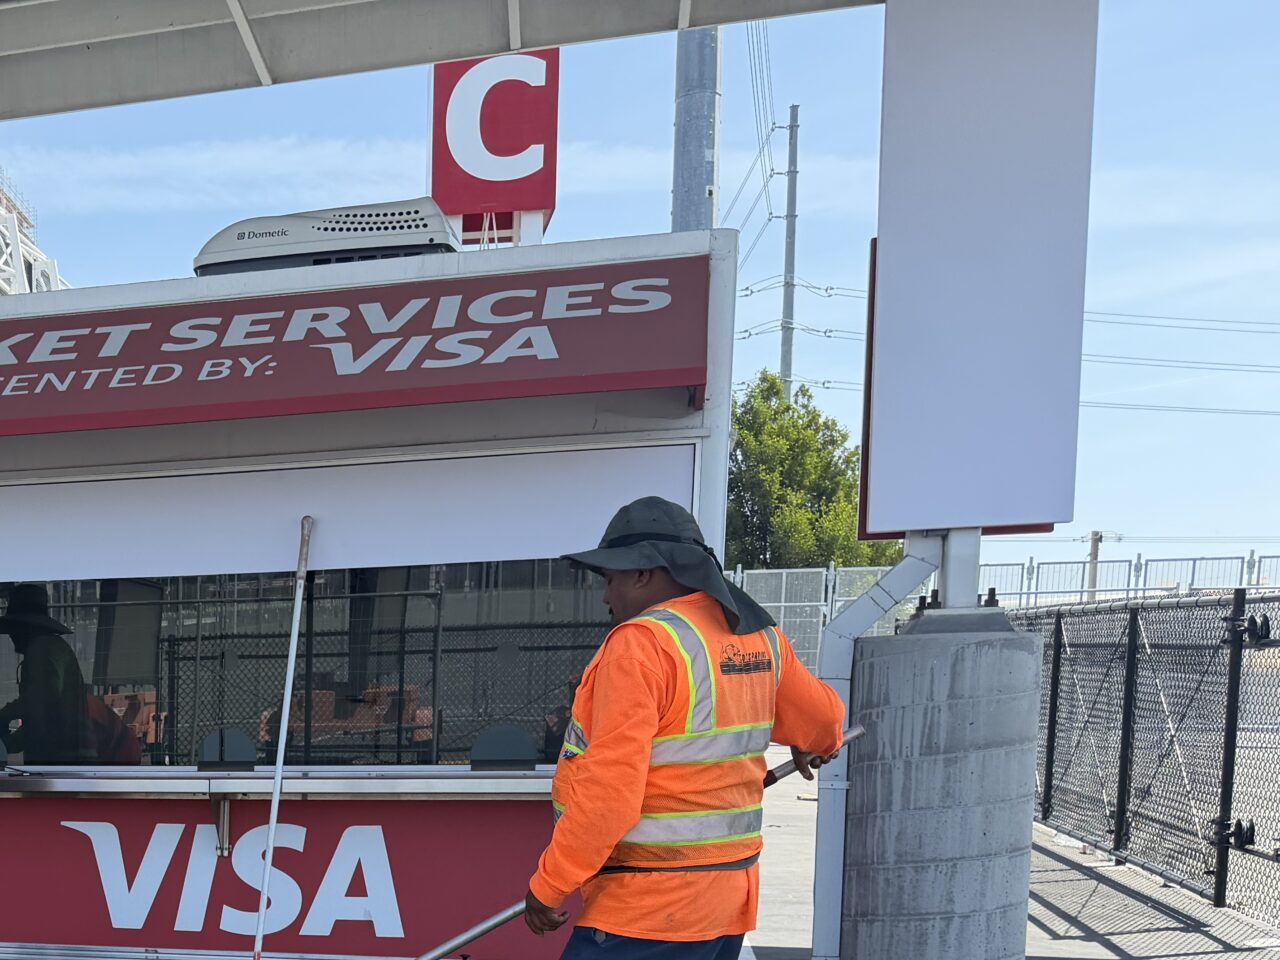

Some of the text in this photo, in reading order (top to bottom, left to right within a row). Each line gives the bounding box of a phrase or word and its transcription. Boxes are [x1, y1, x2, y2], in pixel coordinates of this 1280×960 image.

[445, 53, 547, 181] C
[247, 228, 289, 239] Dometic
[160, 278, 672, 352] SERVICES
[197, 354, 278, 381] BY:
[309, 325, 560, 376] VISA
[60, 821, 405, 938] VISA
